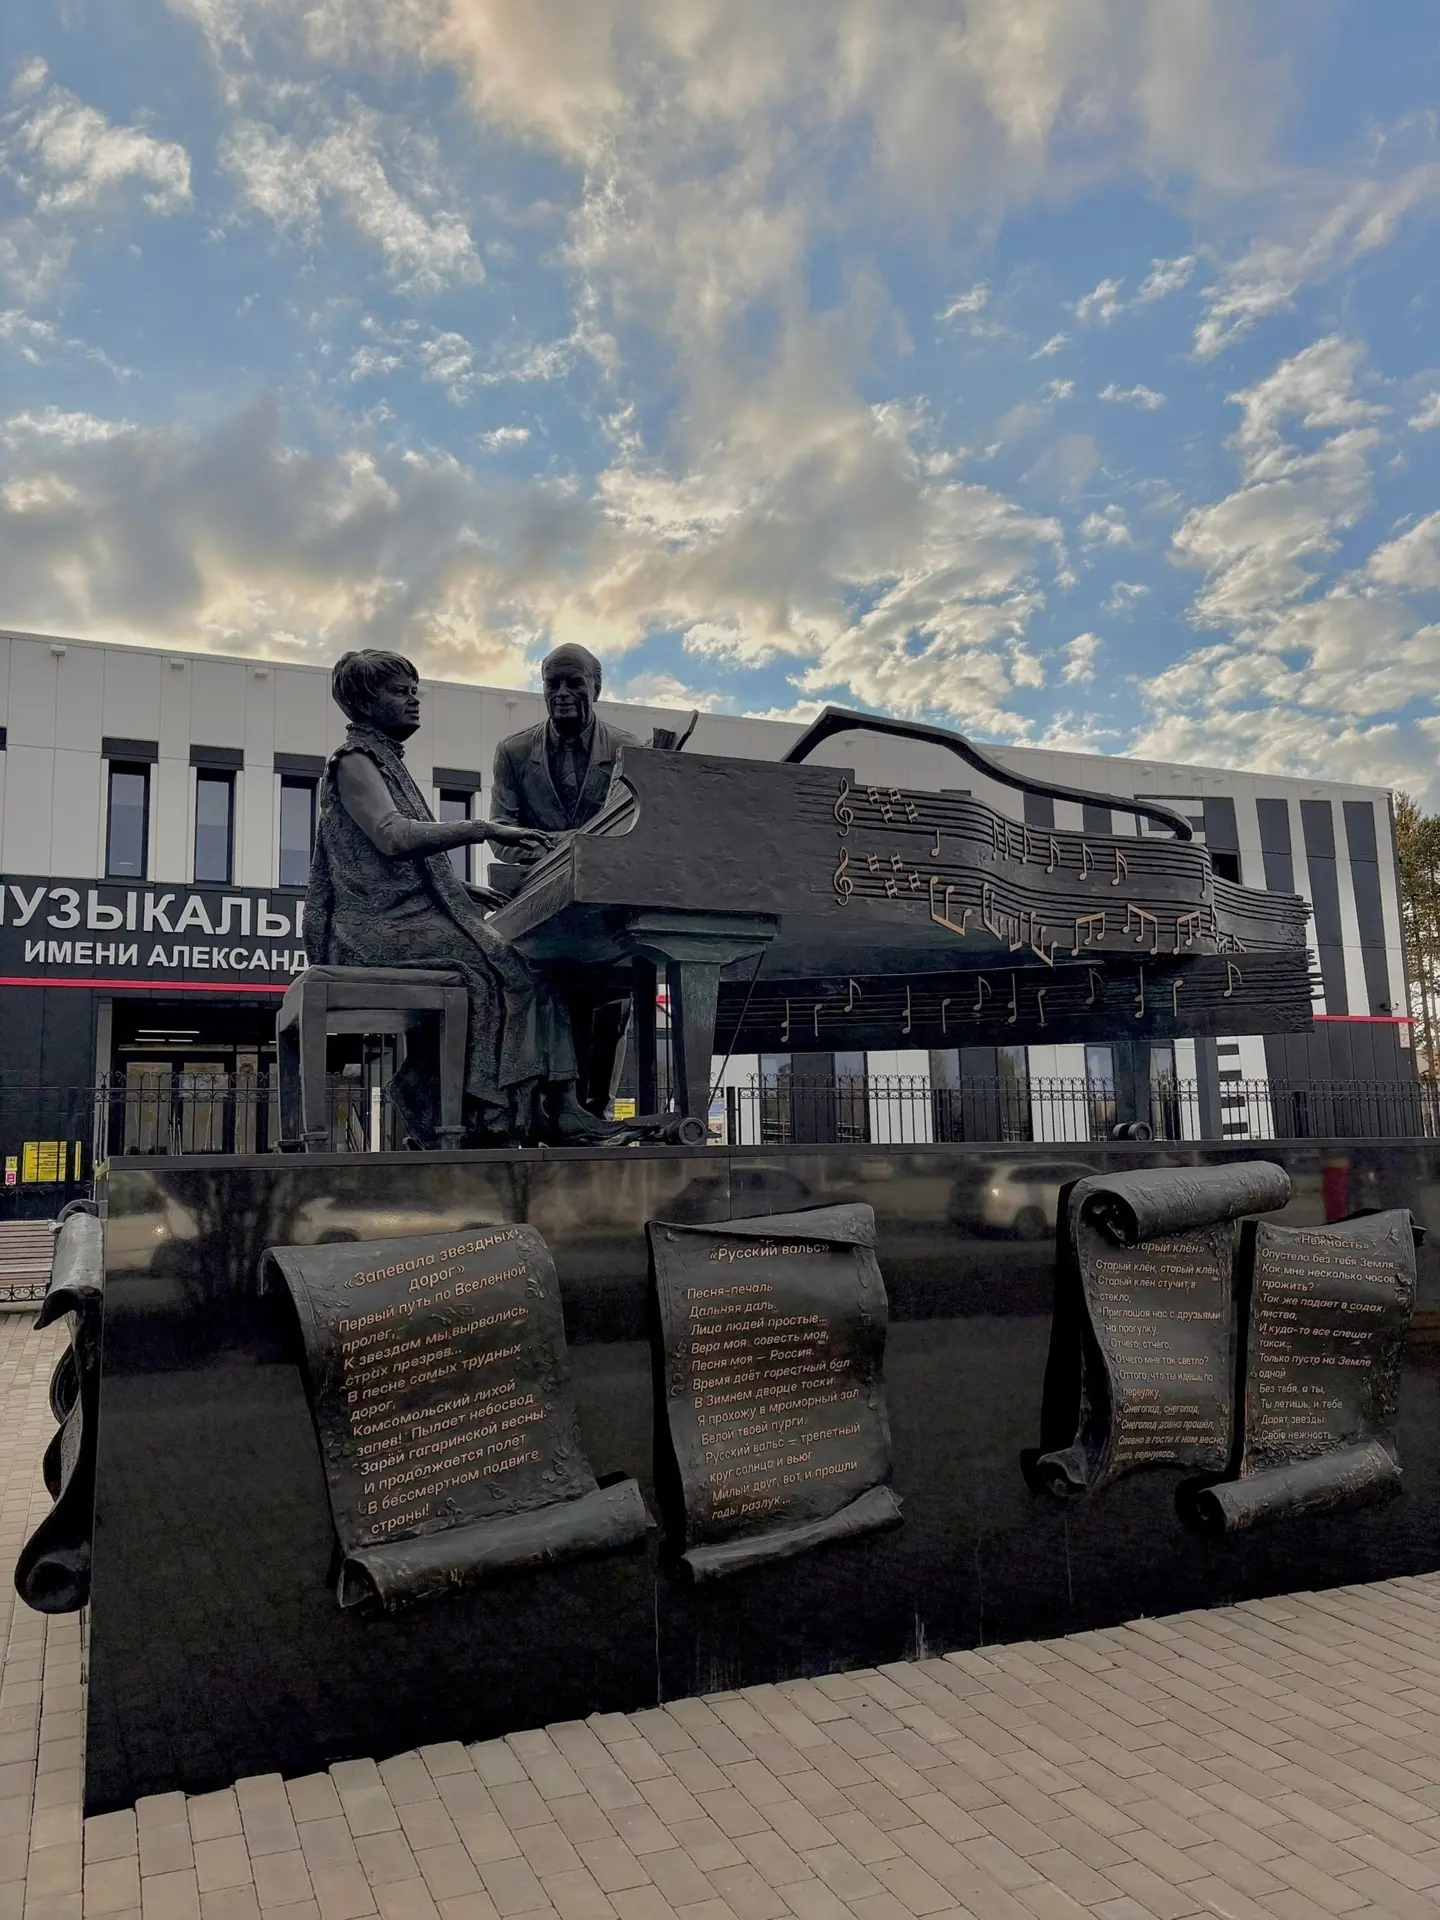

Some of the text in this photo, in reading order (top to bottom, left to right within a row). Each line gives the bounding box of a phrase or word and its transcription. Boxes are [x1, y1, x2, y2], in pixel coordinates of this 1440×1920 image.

[0, 884, 306, 938] УЗЫКАЛЬ
[25, 939, 309, 975] ИМЕНИ АЛЕКСАНД
[1174, 1243, 1204, 1253] клён»
[1295, 1234, 1369, 1249] «Нежность»
[709, 1243, 829, 1264] «Русский вальс»
[1262, 1249, 1357, 1266] Опустела без тебя
[344, 1254, 435, 1289] «Запевала
[1096, 1260, 1131, 1271] Старый
[1134, 1262, 1157, 1273] клён,
[1161, 1264, 1193, 1275] старый
[1262, 1264, 1395, 1283] Как мне несколько часов
[408, 1264, 465, 1293] дорог»
[1098, 1276, 1131, 1286] Старый
[1134, 1277, 1155, 1286] клён
[1158, 1280, 1188, 1290] стучит
[1262, 1280, 1314, 1291] прожить?
[339, 1262, 527, 1333] Первый путь по Вселенной
[1100, 1293, 1131, 1303] стекло,
[1263, 1293, 1280, 1303] Так
[1282, 1297, 1298, 1305] же
[1300, 1298, 1338, 1308] падает
[689, 1304, 741, 1319] Дальняя
[1103, 1307, 1149, 1319] Приглашая
[1177, 1311, 1220, 1322] друзьями
[1260, 1309, 1297, 1320] листва,
[691, 1324, 722, 1336] Лица
[725, 1318, 764, 1333] людей
[1259, 1323, 1267, 1332] И
[1313, 1327, 1330, 1336] все
[1333, 1330, 1373, 1339] спешат
[342, 1328, 396, 1353] пролег,
[691, 1341, 720, 1355] Вера
[754, 1333, 799, 1346] совесть
[1111, 1338, 1140, 1349] Отчего,
[344, 1357, 354, 1370] К
[359, 1339, 421, 1365] звездам
[692, 1348, 814, 1372] Песня моя Россия.
[1116, 1354, 1142, 1365] Отчего
[1162, 1357, 1175, 1365] так
[1178, 1356, 1208, 1366] светло?
[1259, 1353, 1371, 1367] Только пусто на Земле
[345, 1365, 387, 1387] страх
[348, 1343, 522, 1403] В песне самых трудных
[692, 1359, 850, 1392] Время даёт горестный бал
[1120, 1370, 1149, 1381] Оттого,
[1204, 1373, 1213, 1381] по
[1259, 1368, 1285, 1378] одной
[695, 1383, 797, 1408] В Зимнем дворце
[1259, 1383, 1274, 1393] Без
[350, 1400, 396, 1422] дорог,
[353, 1379, 516, 1437] Комсомольский лихой
[698, 1389, 858, 1427] Я прохожу в мраморный зал
[1261, 1399, 1271, 1408] Ты
[1322, 1397, 1342, 1408] тебе
[357, 1393, 534, 1456] запев! Пылает небосвод
[1121, 1420, 1157, 1431] Снегопад
[1158, 1421, 1181, 1429] давно
[1261, 1415, 1288, 1426] Дарят
[360, 1409, 546, 1475] Зарёй гагаринской весны.
[702, 1428, 734, 1445] Белой
[737, 1422, 768, 1437] твоей
[706, 1423, 861, 1464] Русский вальс трепетный
[1118, 1436, 1224, 1446] Словно в гости к нам весна
[1262, 1430, 1285, 1440] Свою
[364, 1433, 527, 1494] И продолжается полёт
[710, 1458, 783, 1484] круг солнца и
[368, 1450, 539, 1515] В бессмертном подвиге
[713, 1460, 857, 1502] Милый друг, вот и прошли
[371, 1503, 429, 1534] страны!
[712, 1505, 738, 1520] годы
